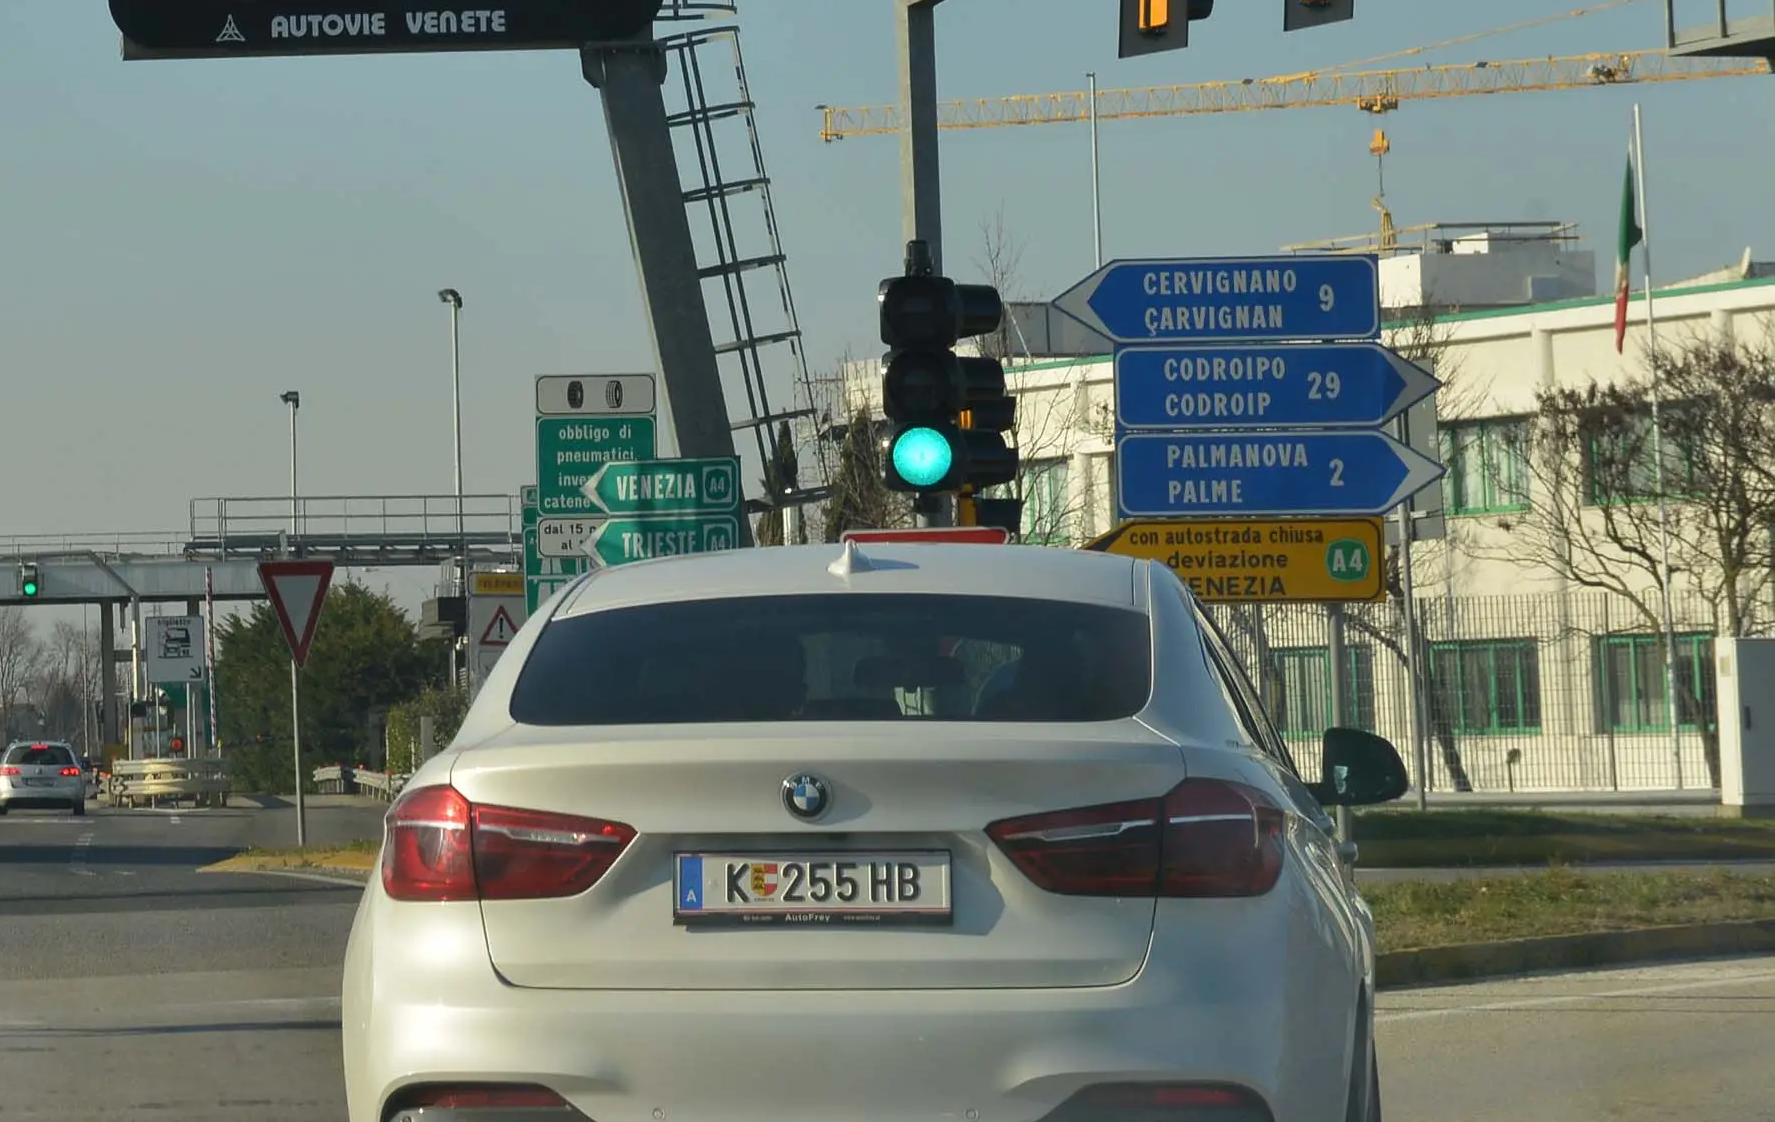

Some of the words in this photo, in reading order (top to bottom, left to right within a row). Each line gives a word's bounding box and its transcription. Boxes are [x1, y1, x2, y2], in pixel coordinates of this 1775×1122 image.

[271, 12, 385, 39] AUTOVIE
[406, 9, 506, 34] VENETE
[1144, 269, 1297, 296] CERVIGNANO
[1319, 284, 1335, 312] 9
[1145, 305, 1283, 336] ÇARVIGNAN
[1164, 357, 1286, 381] CODROIPO
[1308, 372, 1340, 399] 29
[1165, 392, 1271, 417] CODROIP
[559, 425, 609, 441] obbligo
[619, 424, 631, 439] di
[1167, 443, 1308, 469] PALMANOVA
[1329, 459, 1344, 487] 2
[616, 473, 696, 501] VENEZIA
[710, 478, 725, 493] A4
[1168, 480, 1243, 503] PALME
[544, 494, 590, 508] catene
[544, 523, 563, 534] dal
[570, 523, 583, 534] 15
[1130, 529, 1159, 545] con
[1165, 527, 1261, 545] autostrada
[1269, 526, 1323, 544] chiusa
[561, 539, 572, 550] al
[621, 530, 696, 559] TRIESTE
[1167, 548, 1288, 569] deviazione
[1332, 548, 1363, 573] A4
[1190, 575, 1286, 596] ENEZIA
[725, 862, 751, 903] K
[780, 862, 860, 903] 255
[868, 862, 922, 903] HB
[686, 890, 697, 902] A
